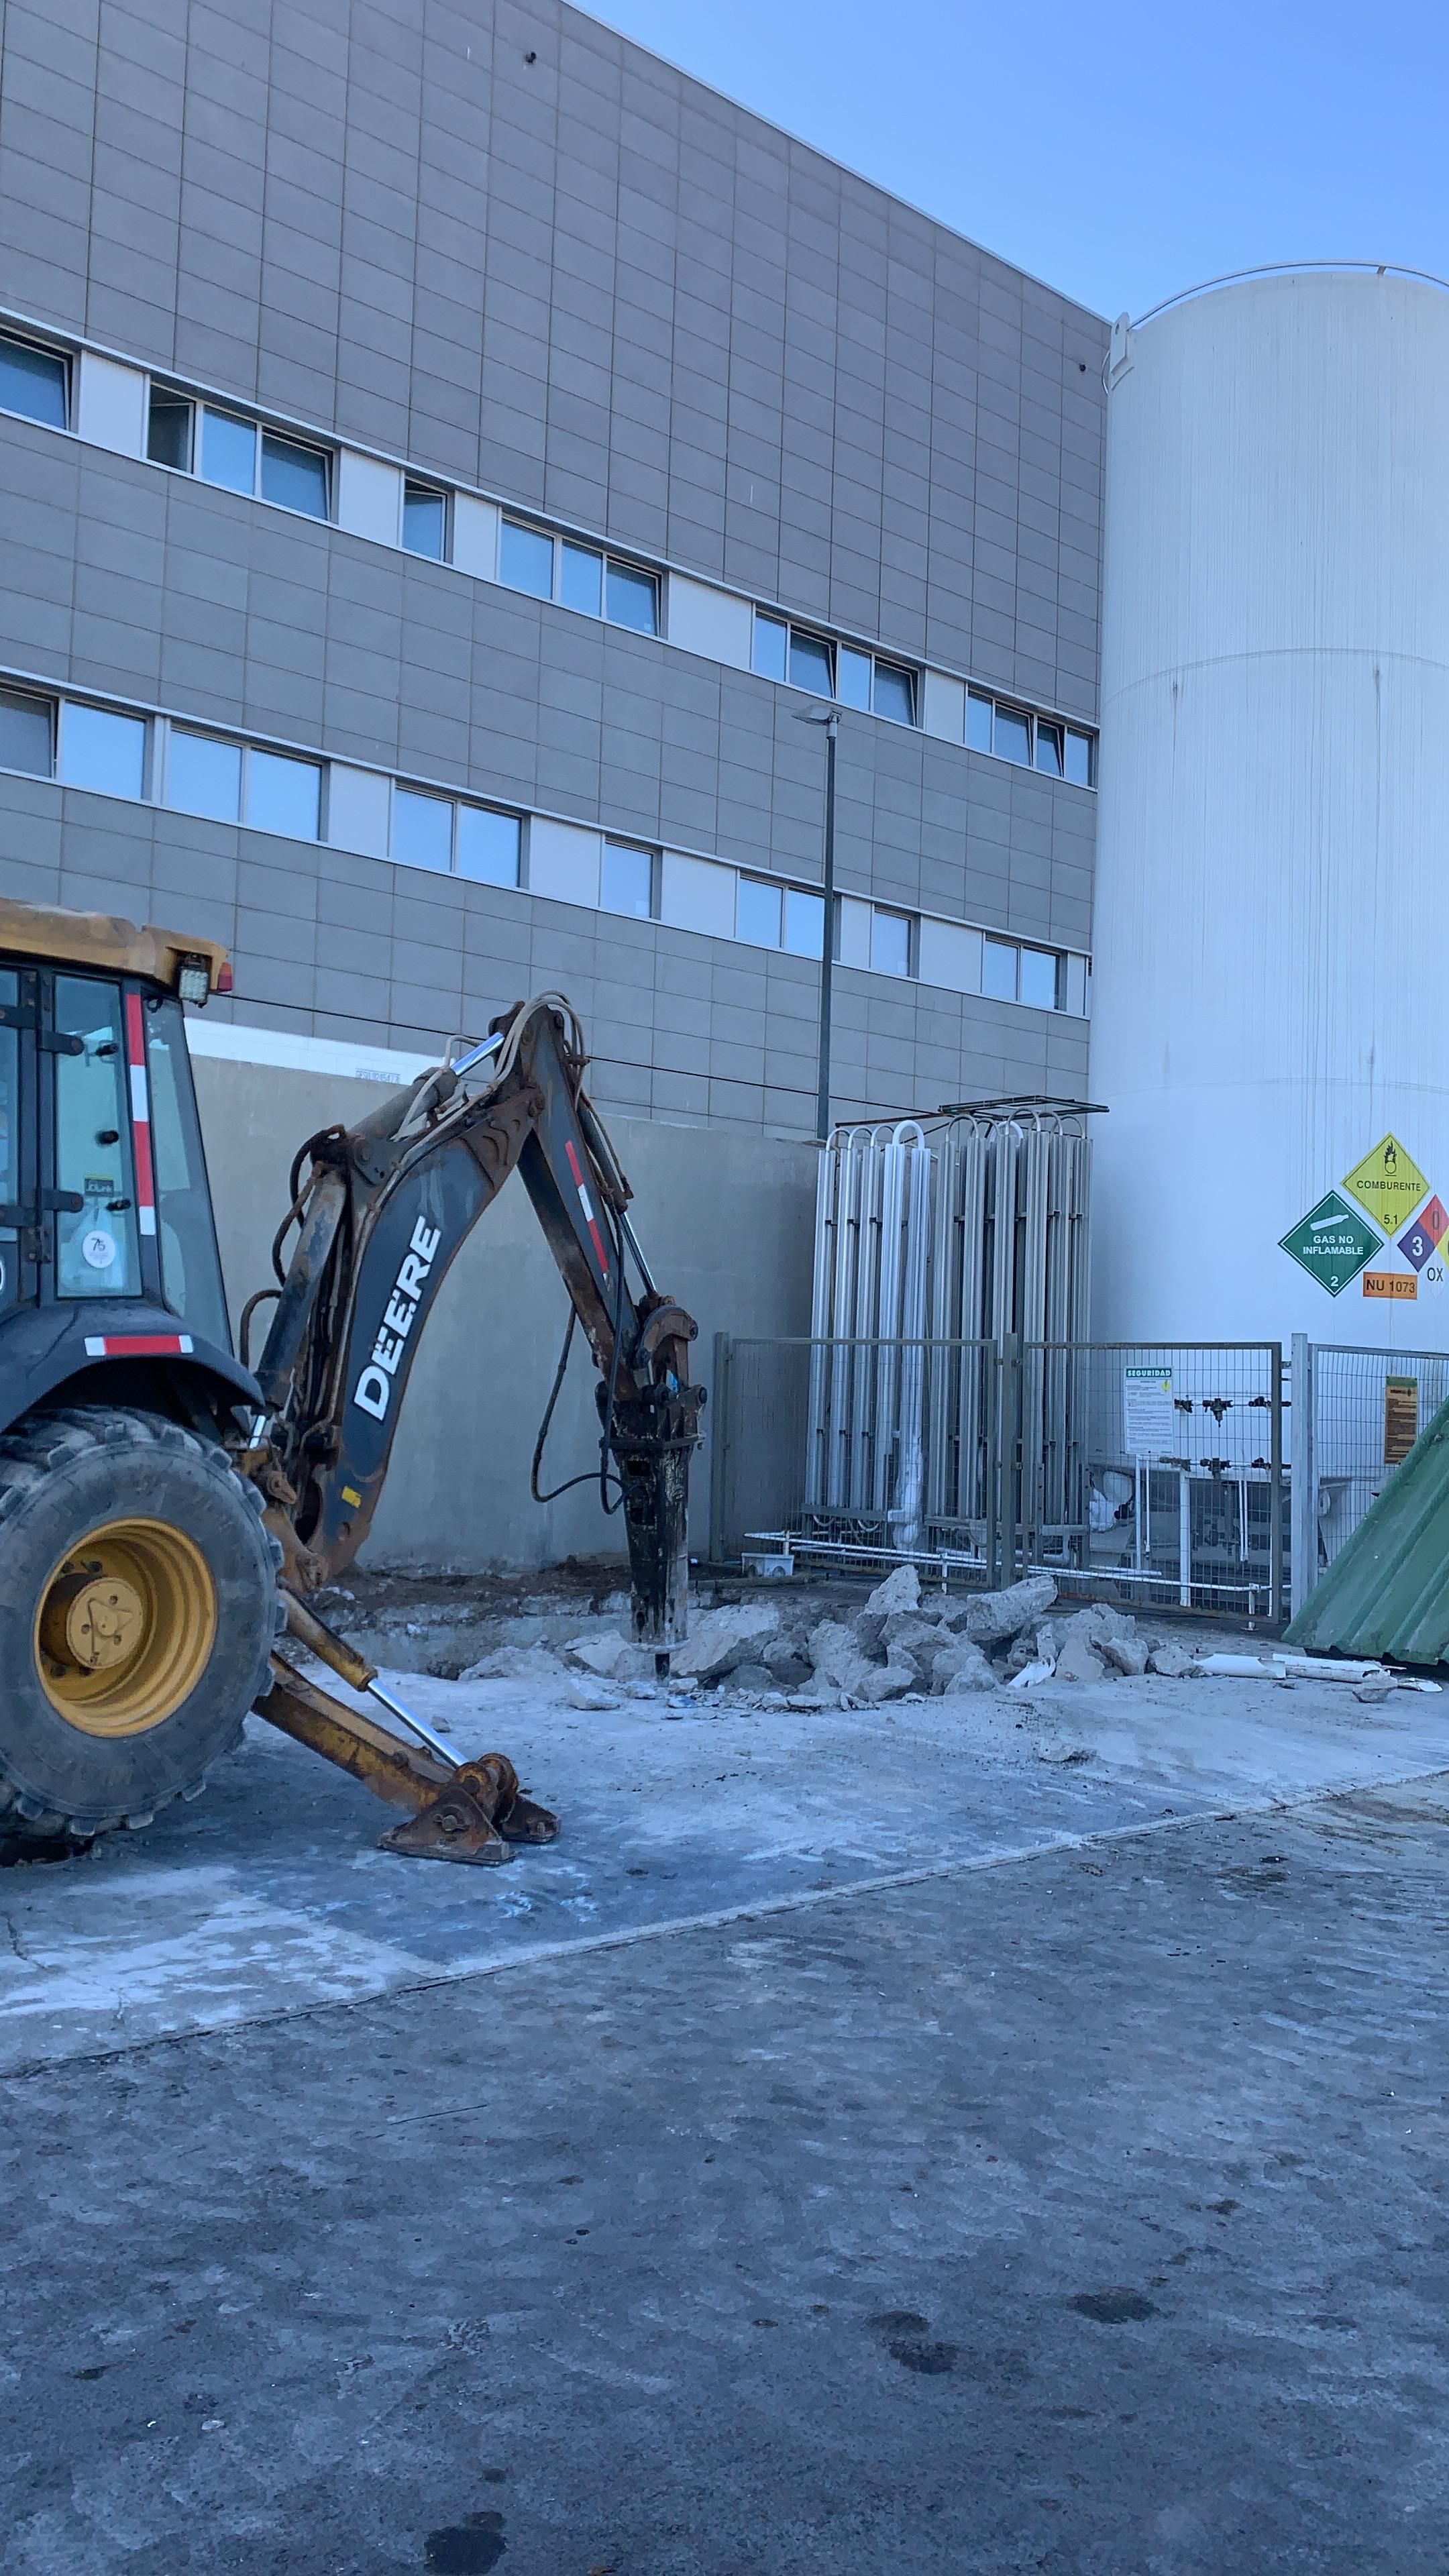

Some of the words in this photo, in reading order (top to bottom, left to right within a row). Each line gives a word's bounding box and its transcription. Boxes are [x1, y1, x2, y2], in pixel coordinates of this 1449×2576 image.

[1356, 1180, 1421, 1191] COMBURENTE
[1384, 1214, 1398, 1225] 5.1
[1313, 1235, 1336, 1244] GAS
[1338, 1236, 1354, 1244] NO
[1303, 1246, 1364, 1255] INFLAMABLE
[1412, 1236, 1423, 1256] 3
[1427, 1267, 1444, 1282] OX
[1330, 1276, 1339, 1287] 2
[1366, 1279, 1385, 1291] NU
[1389, 1281, 1415, 1293] 1073
[354, 1215, 441, 1421] DEERE
